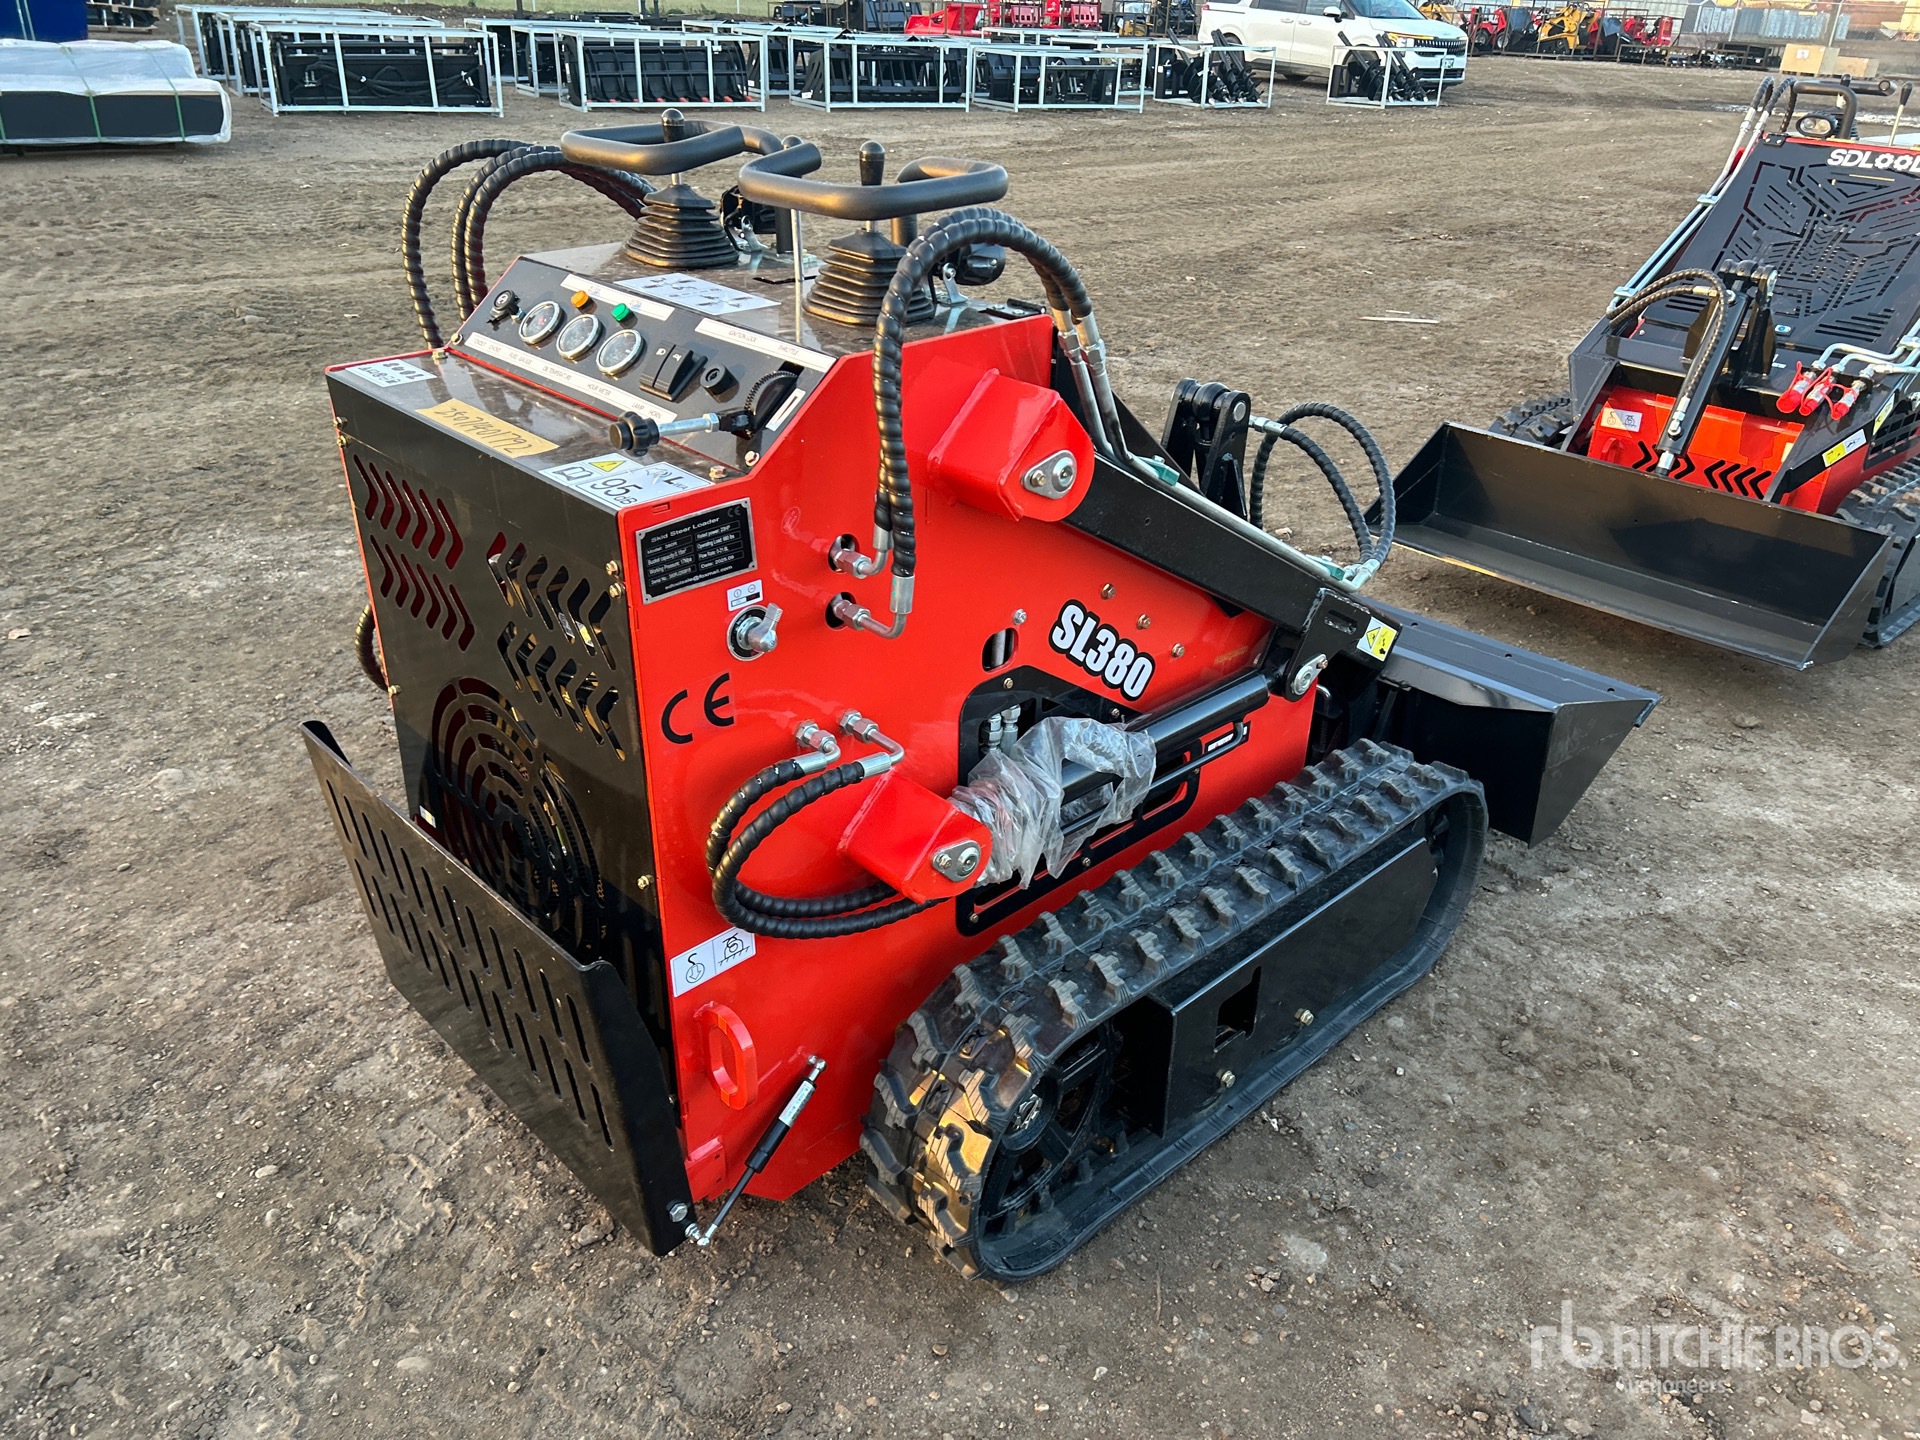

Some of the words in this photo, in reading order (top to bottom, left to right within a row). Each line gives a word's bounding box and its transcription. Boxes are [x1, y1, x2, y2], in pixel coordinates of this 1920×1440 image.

[631, 402, 645, 411] LAMP
[648, 408, 663, 419] HORN
[651, 533, 669, 543] Skid
[669, 526, 691, 537] Steer
[692, 517, 720, 529] Loader
[1050, 601, 1155, 700] SL380
[661, 672, 735, 744] CE
